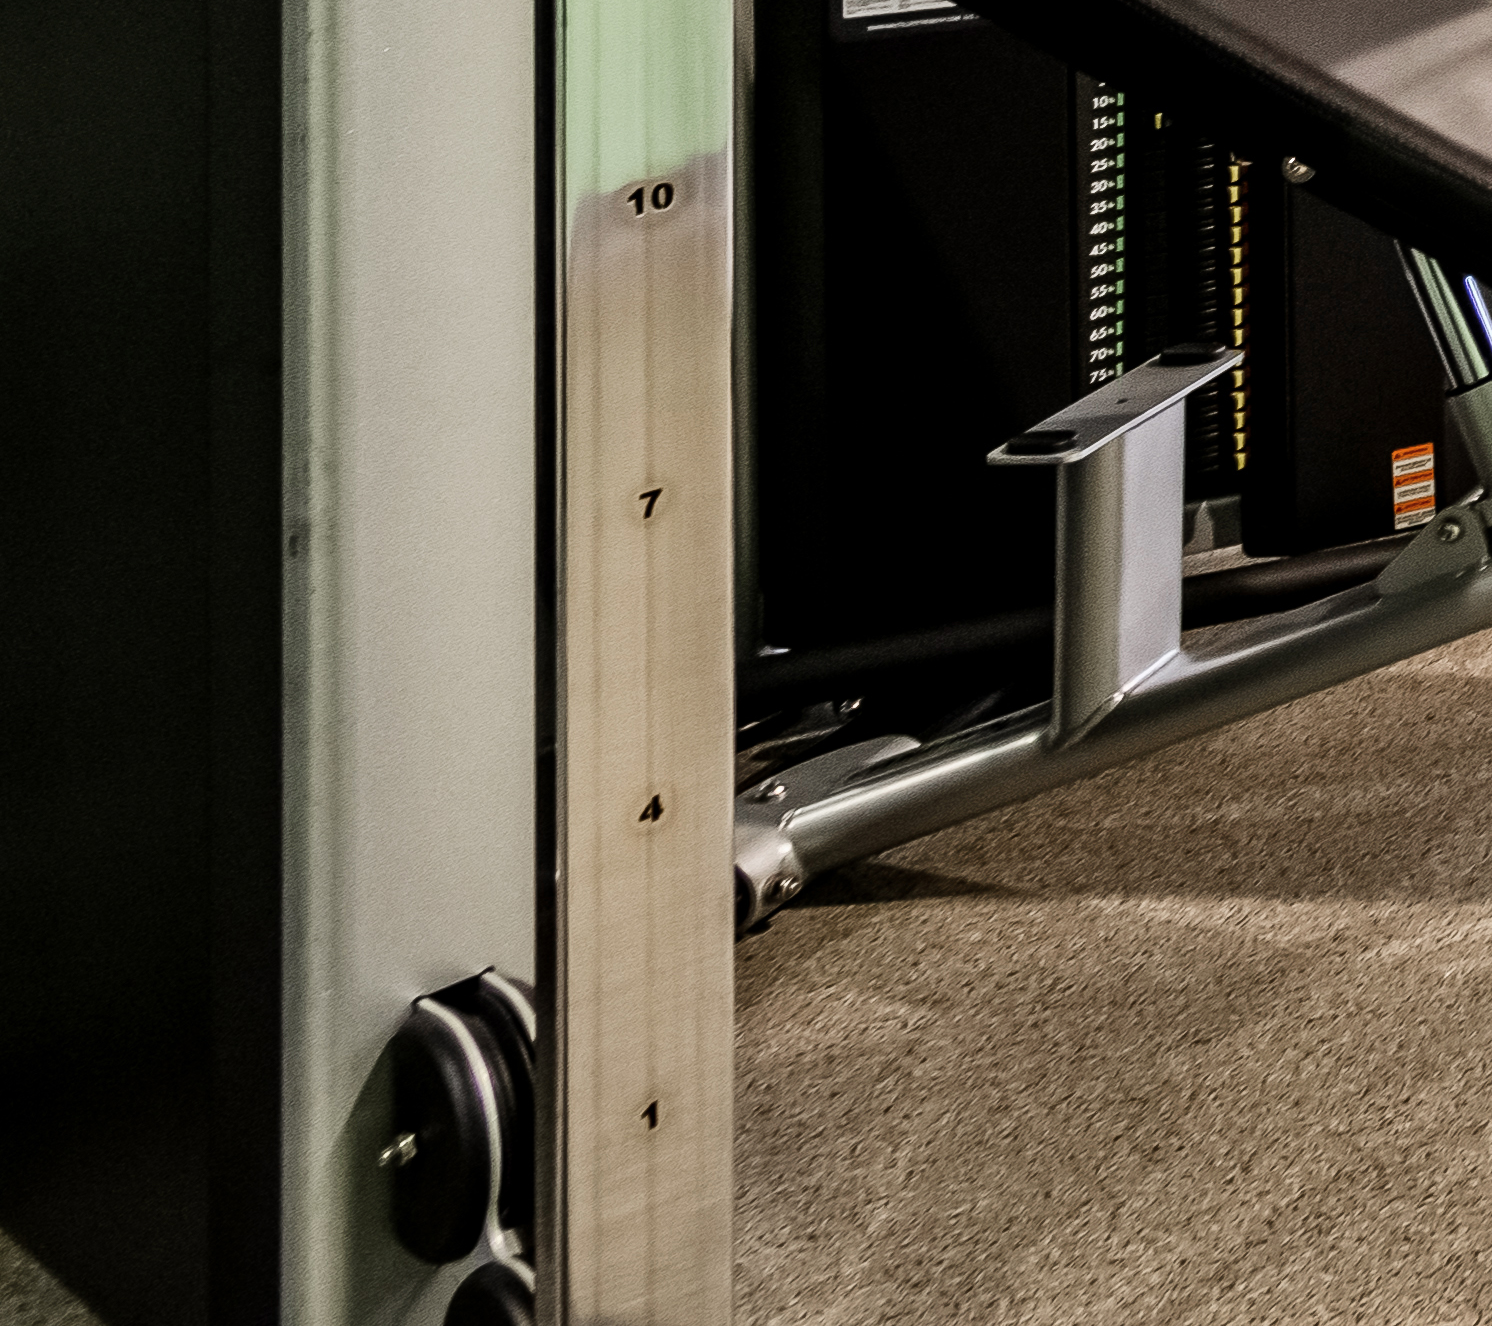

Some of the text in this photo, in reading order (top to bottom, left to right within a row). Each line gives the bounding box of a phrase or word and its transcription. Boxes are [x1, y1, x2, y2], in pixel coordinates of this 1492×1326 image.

[627, 181, 674, 216] 10
[639, 487, 664, 520] 7
[639, 794, 664, 822] 4
[641, 1099, 659, 1131] 1
